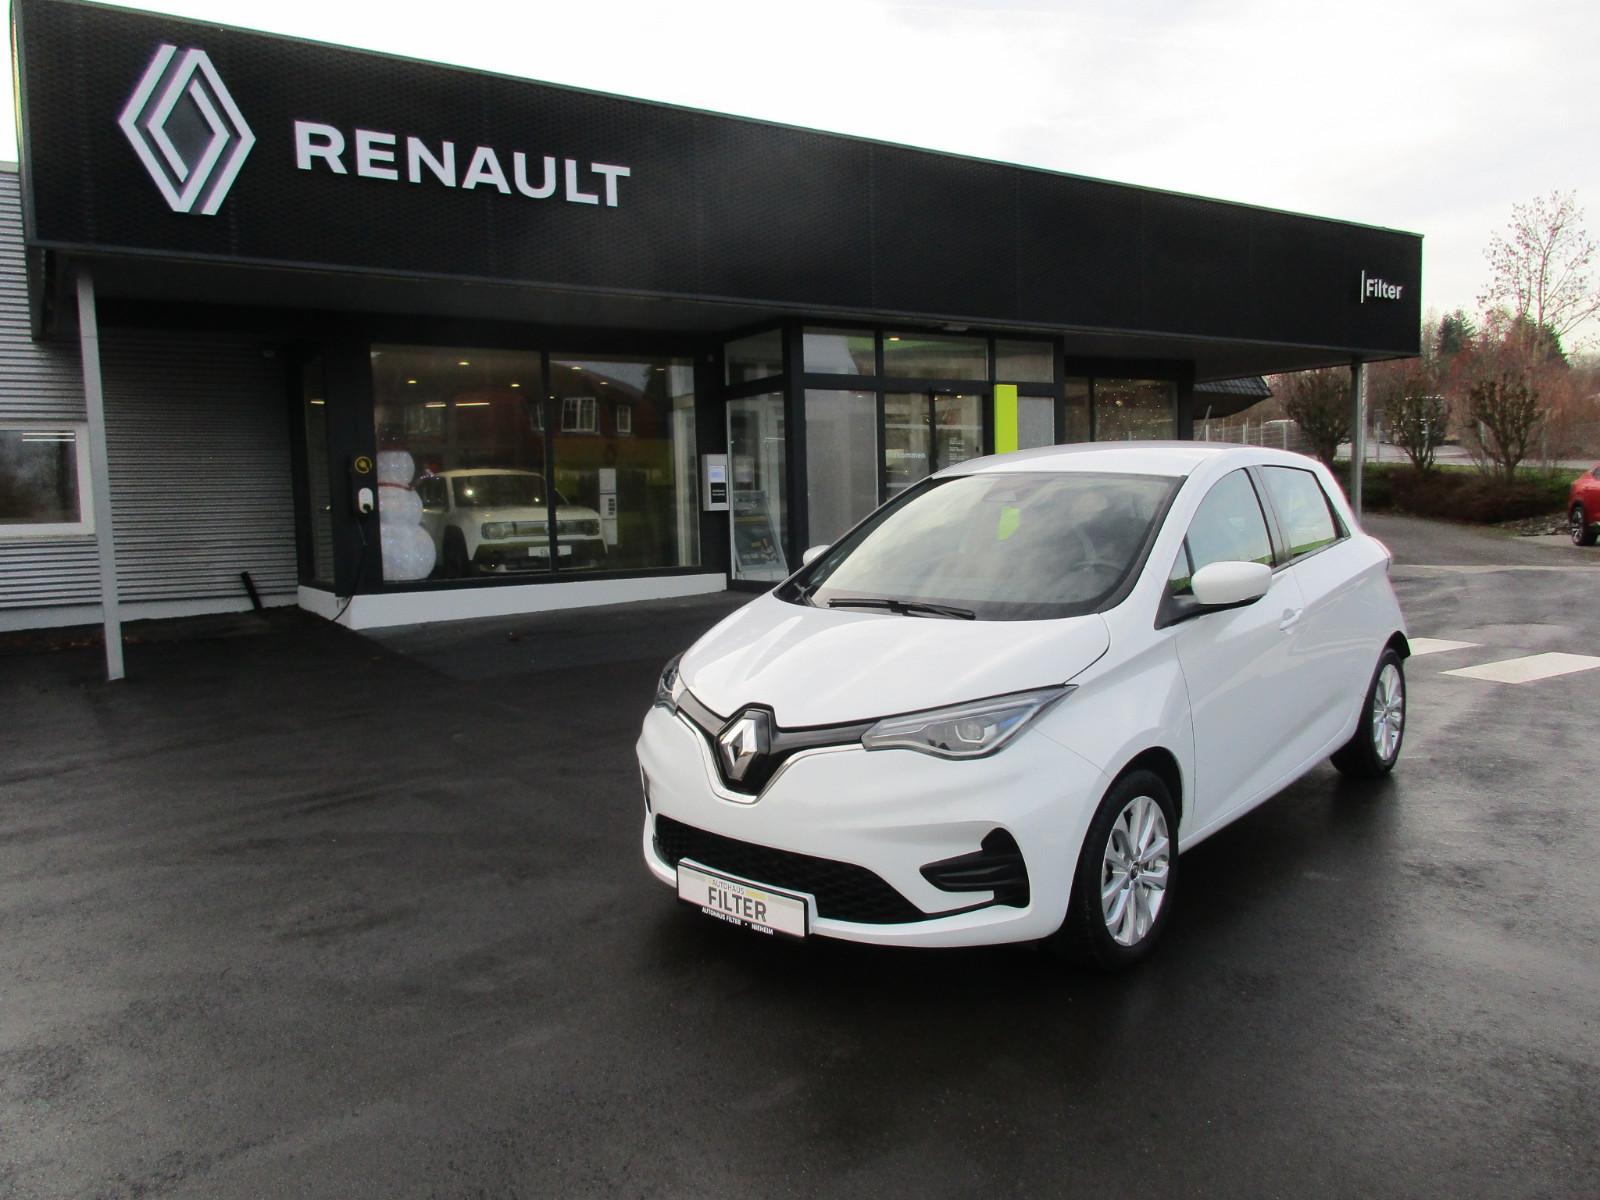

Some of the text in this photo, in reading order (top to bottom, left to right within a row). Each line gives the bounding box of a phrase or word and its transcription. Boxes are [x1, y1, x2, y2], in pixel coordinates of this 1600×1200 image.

[294, 120, 631, 207] RENAULT
[1366, 278, 1403, 300] Filter
[712, 879, 745, 895] AUTOHAUS
[708, 886, 767, 923] FILTER
[701, 906, 726, 921] AUTOHAUS
[725, 914, 742, 926] FILTER
